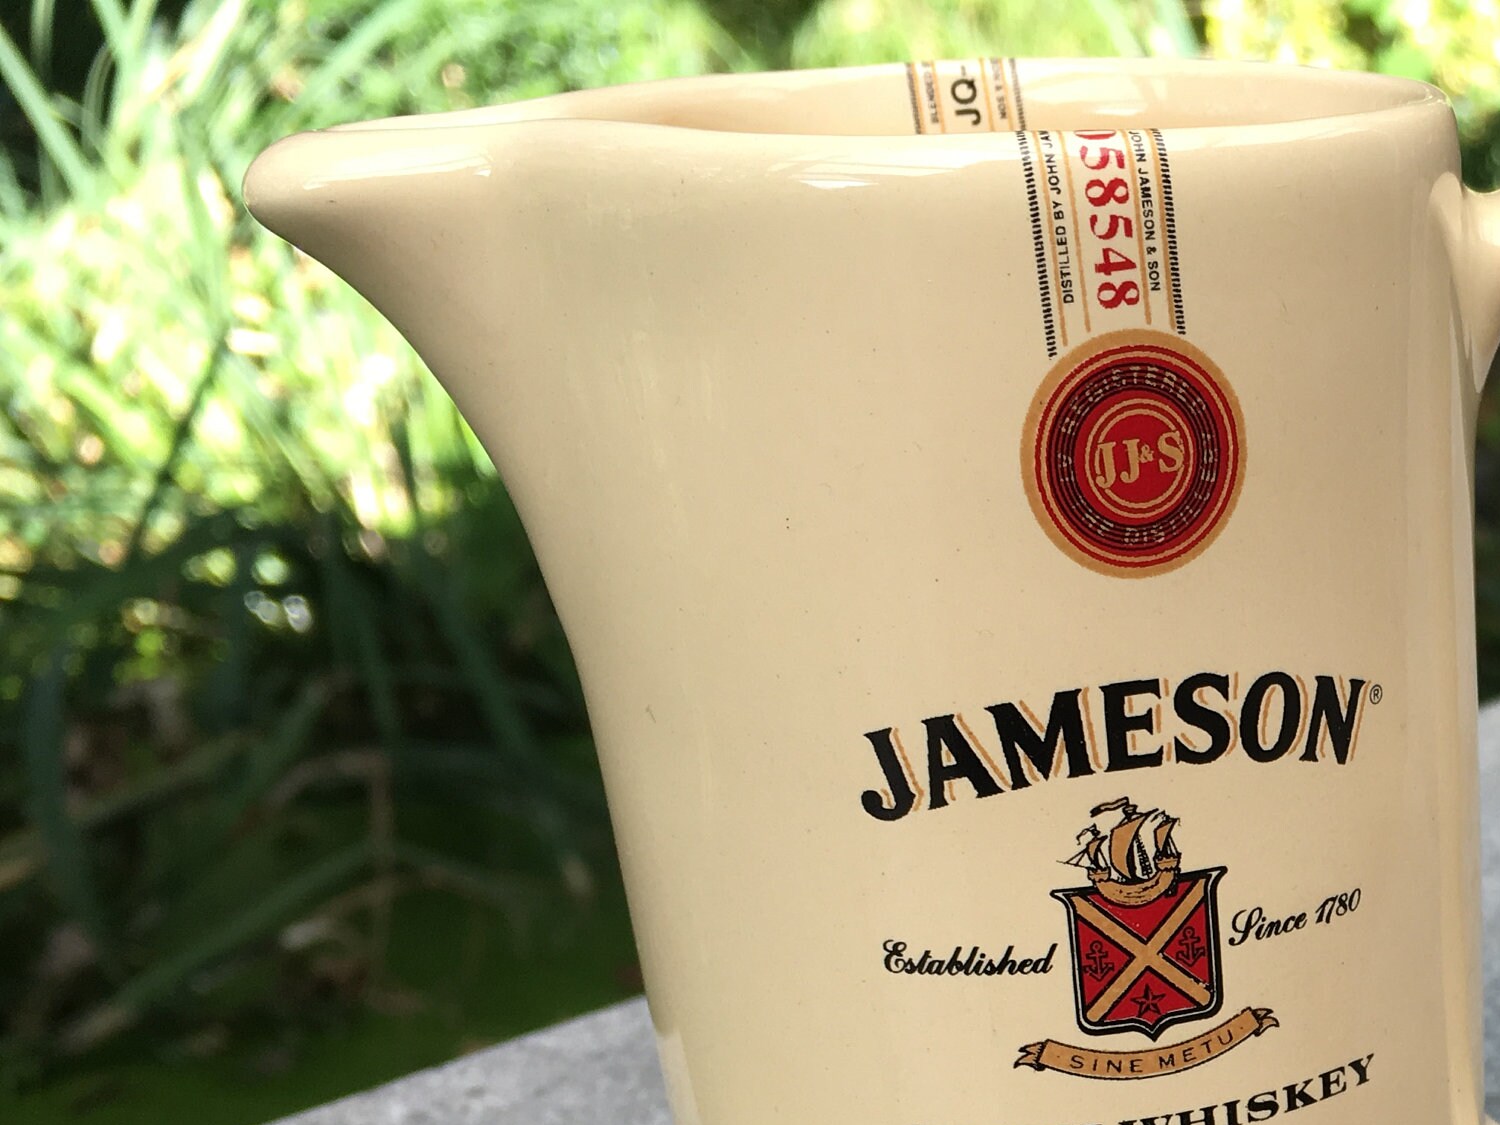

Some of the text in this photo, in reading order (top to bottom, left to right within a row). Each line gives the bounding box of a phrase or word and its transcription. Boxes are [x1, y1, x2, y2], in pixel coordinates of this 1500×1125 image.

[1044, 153, 1062, 195] JOHN
[1051, 200, 1065, 221] BY
[1128, 130, 1161, 292] JOHN JAMESON & SON
[1055, 225, 1075, 304] DISTILLED
[1228, 888, 1362, 947] Since 1780
[882, 939, 1058, 976] Established
[1069, 1029, 1235, 1074] SINE METU
